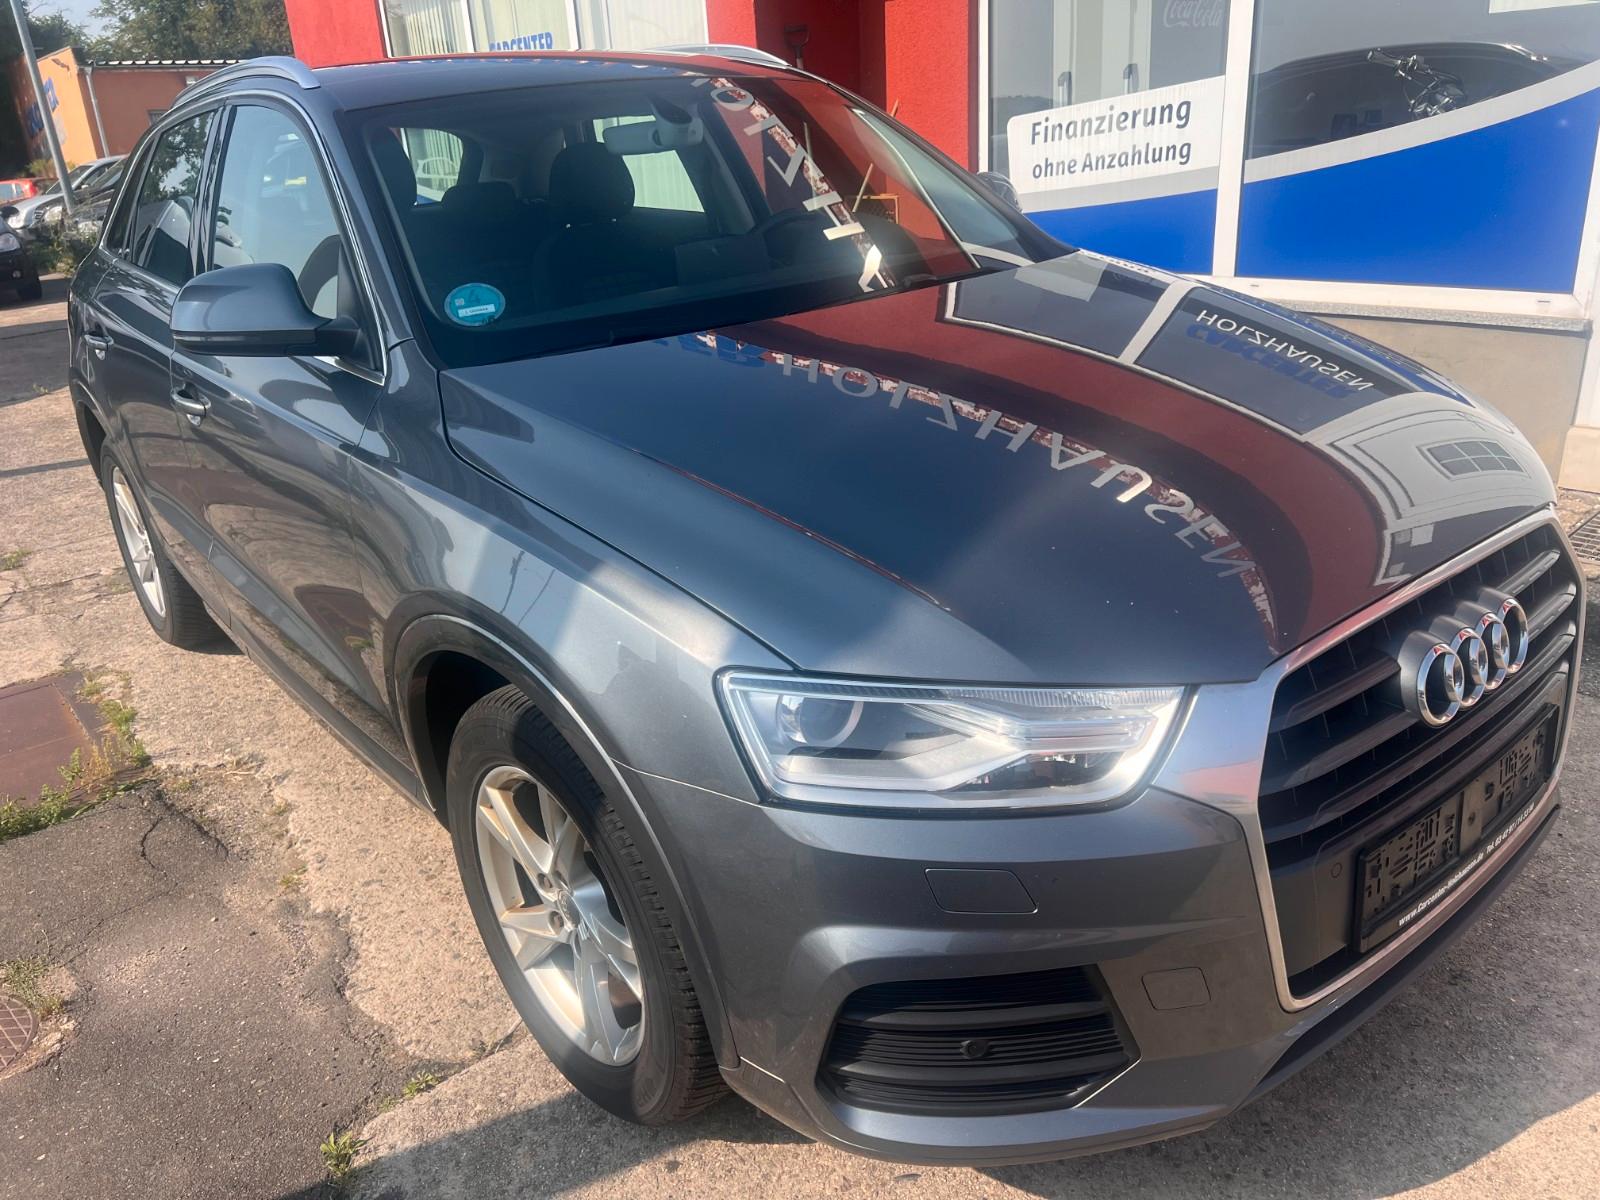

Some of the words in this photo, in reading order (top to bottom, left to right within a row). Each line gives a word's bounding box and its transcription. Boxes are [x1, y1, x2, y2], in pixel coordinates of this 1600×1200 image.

[1031, 100, 1192, 145] Finanzierung
[1032, 157, 1077, 178] ohne
[1081, 142, 1192, 173] Anzahlung
